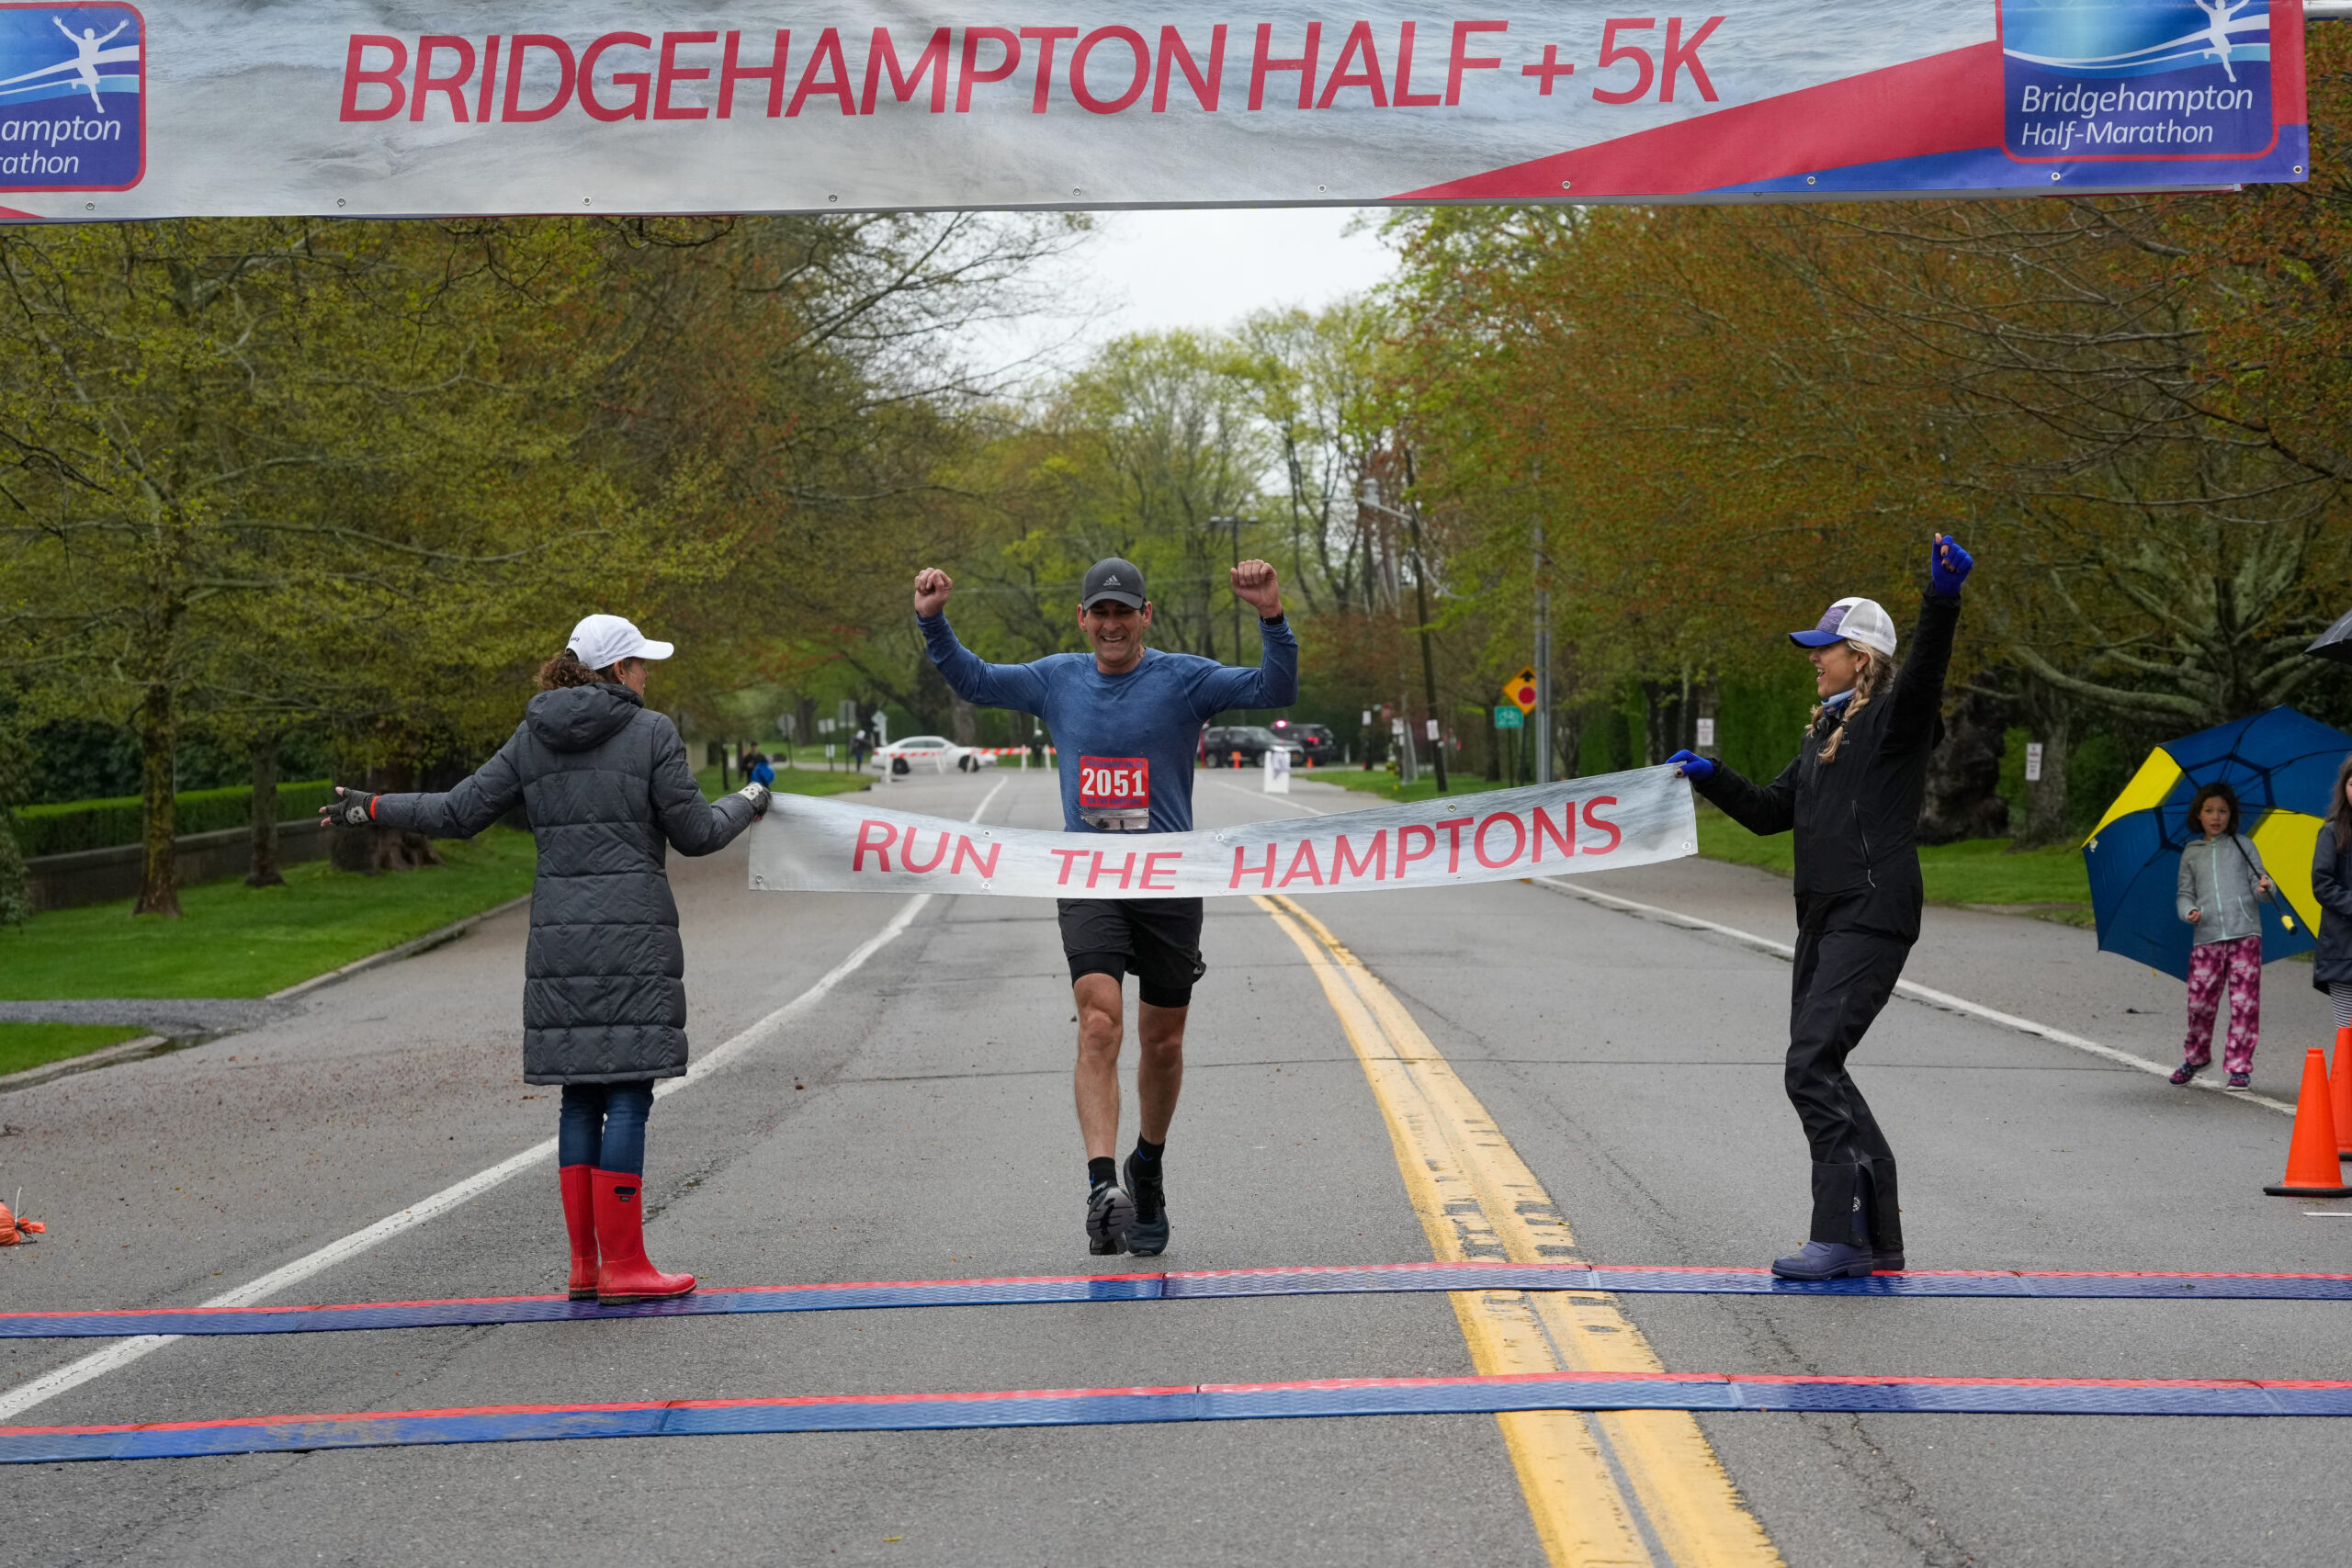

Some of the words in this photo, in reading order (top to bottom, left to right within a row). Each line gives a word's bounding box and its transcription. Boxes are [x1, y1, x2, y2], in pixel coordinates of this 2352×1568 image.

[339, 23, 1227, 123] BRIDGEHAMPTON
[1248, 20, 1509, 110] HALF
[1521, 44, 1575, 96] +
[1592, 16, 1726, 104] 5K
[2021, 84, 2254, 118] Bridgehampton
[1, 116, 121, 147] ampton
[2021, 119, 2213, 151] Half-Marathon
[0, 149, 79, 174] athon
[1081, 768, 1146, 796] 2051
[853, 819, 1001, 878] RUN
[1050, 849, 1183, 890] THE
[1228, 795, 1622, 888] HAMPTONS
